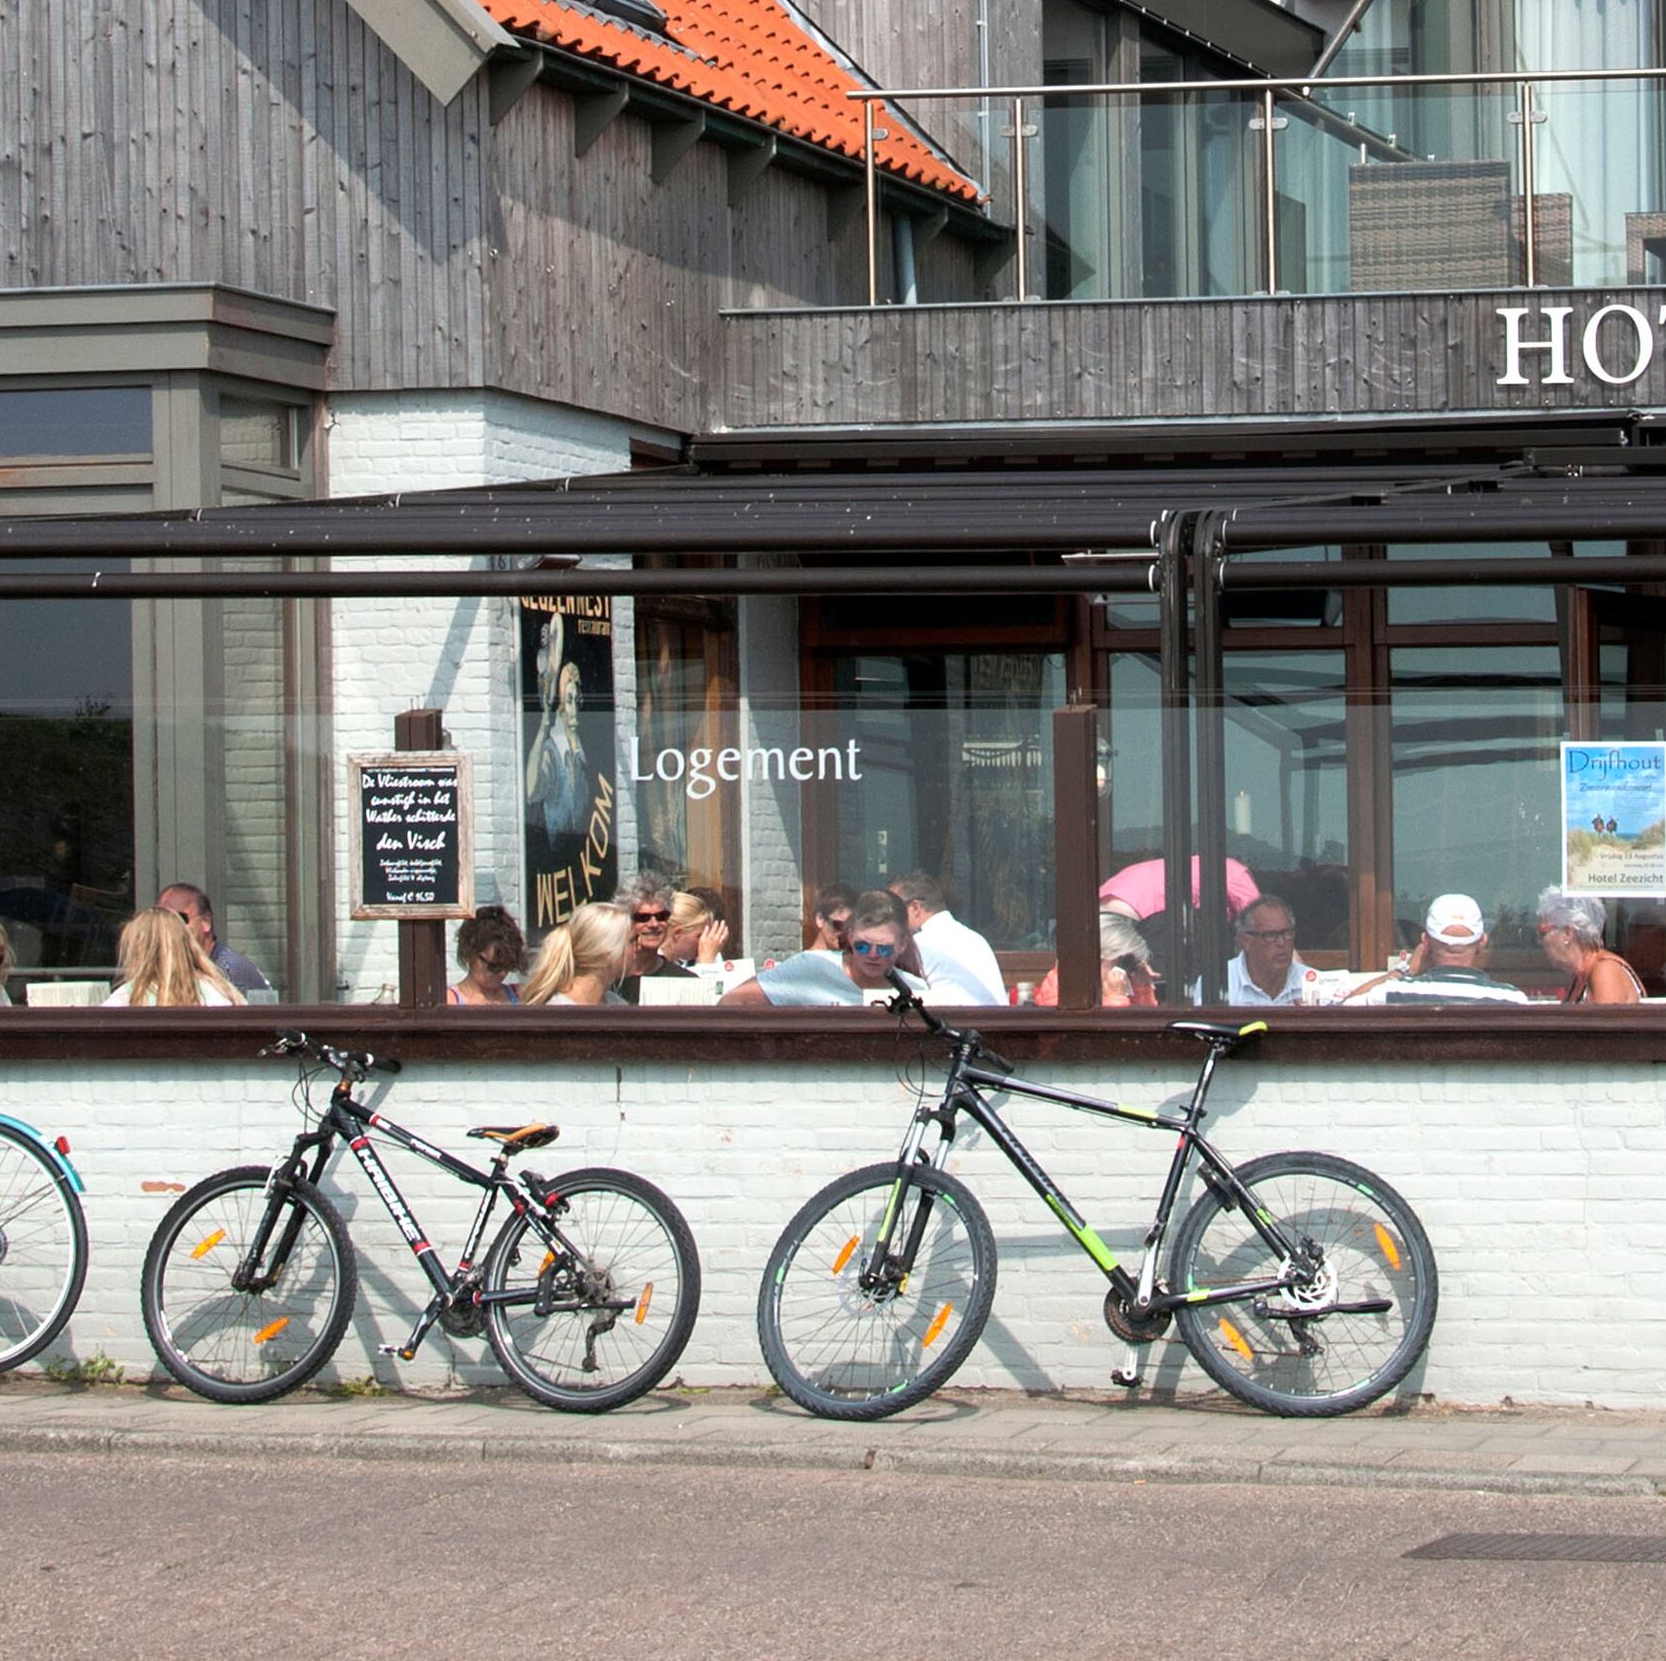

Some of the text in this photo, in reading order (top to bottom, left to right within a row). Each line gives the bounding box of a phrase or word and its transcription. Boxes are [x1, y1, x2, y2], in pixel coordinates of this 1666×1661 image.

[628, 736, 864, 801] Logement
[1569, 750, 1662, 781] Drijfhout
[362, 773, 376, 789] De
[377, 772, 435, 788] Vliestroom
[417, 793, 432, 805] in
[433, 790, 451, 805] het
[376, 830, 446, 851] den Visch
[537, 772, 614, 929] WELKOM
[1588, 873, 1665, 884] Hotel Zeezicht
